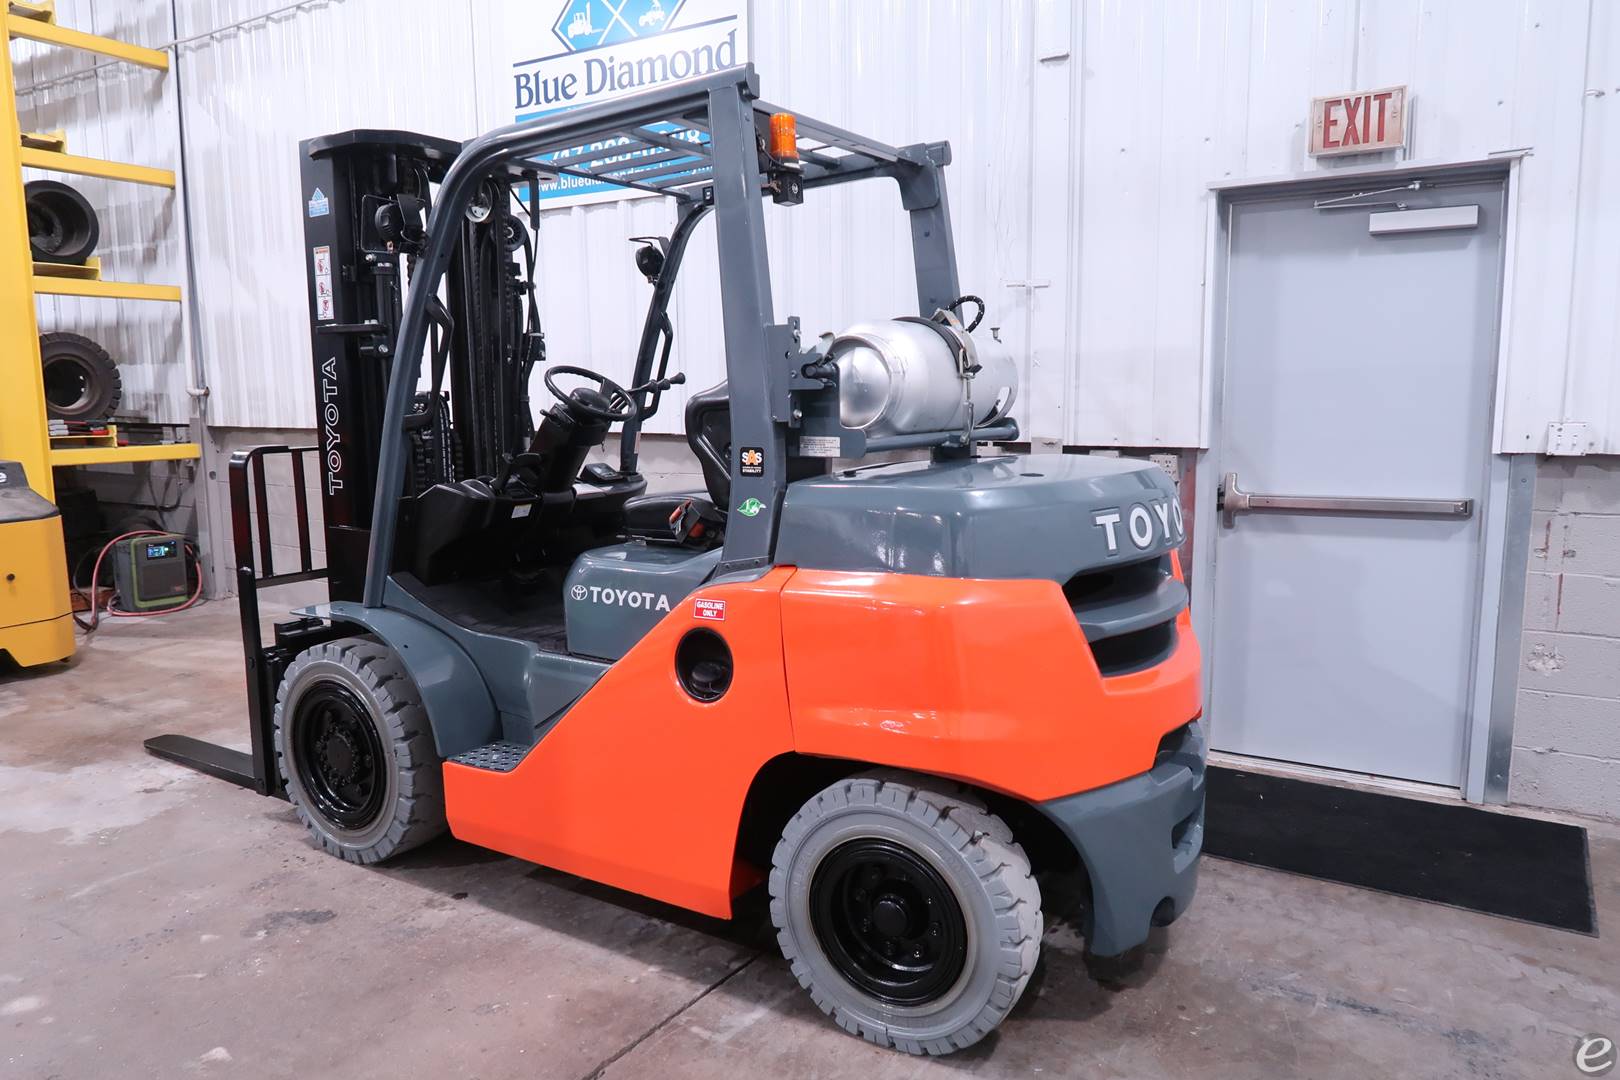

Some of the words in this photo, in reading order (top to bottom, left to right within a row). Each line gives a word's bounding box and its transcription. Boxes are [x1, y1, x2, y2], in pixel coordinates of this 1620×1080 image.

[514, 70, 578, 109] Blue
[584, 28, 737, 96] Diamond
[1323, 92, 1393, 149] EXIT
[322, 356, 344, 496] TOYOTA
[742, 450, 762, 465] SAS
[589, 585, 671, 613] TOYOTA
[697, 601, 723, 610] GASOLINE
[703, 609, 717, 617] ONLY
